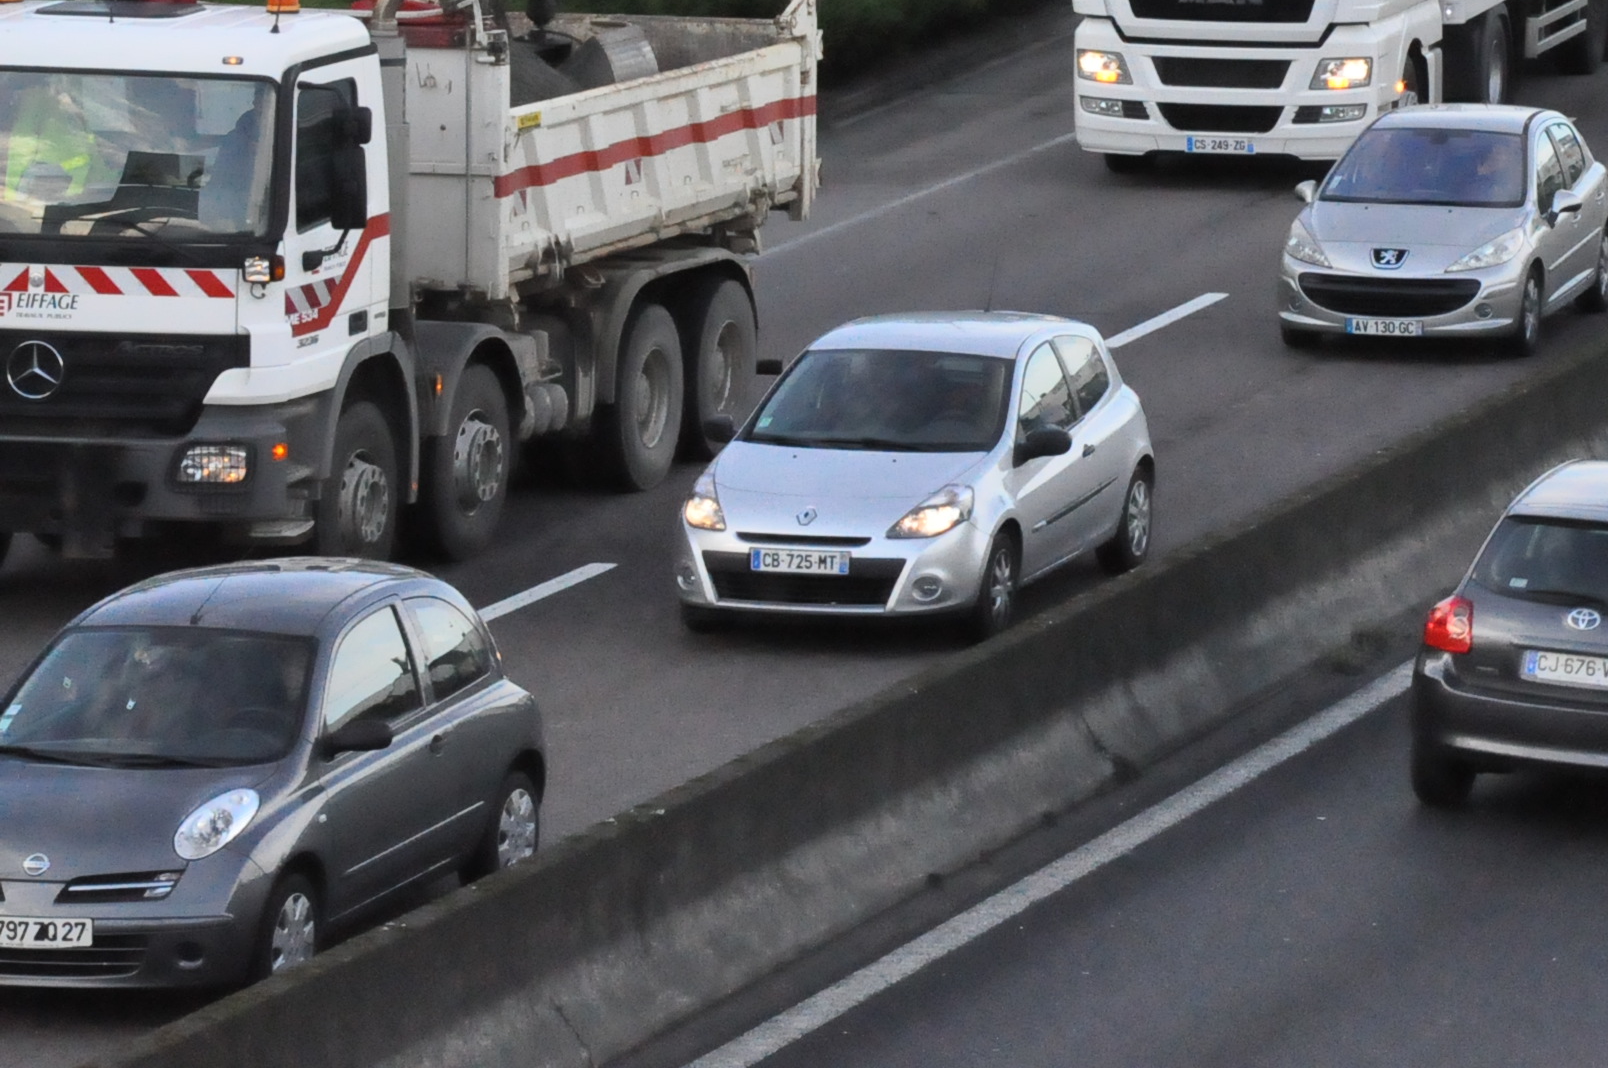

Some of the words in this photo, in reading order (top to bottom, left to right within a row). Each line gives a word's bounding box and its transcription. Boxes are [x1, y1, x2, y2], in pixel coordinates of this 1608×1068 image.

[1194, 139, 1246, 150] CS-249-ZG
[16, 292, 80, 310] EIFFAGE
[1355, 320, 1414, 334] AV-130-GC
[762, 552, 837, 570] CB-725-MT
[61, 922, 87, 942] 27
